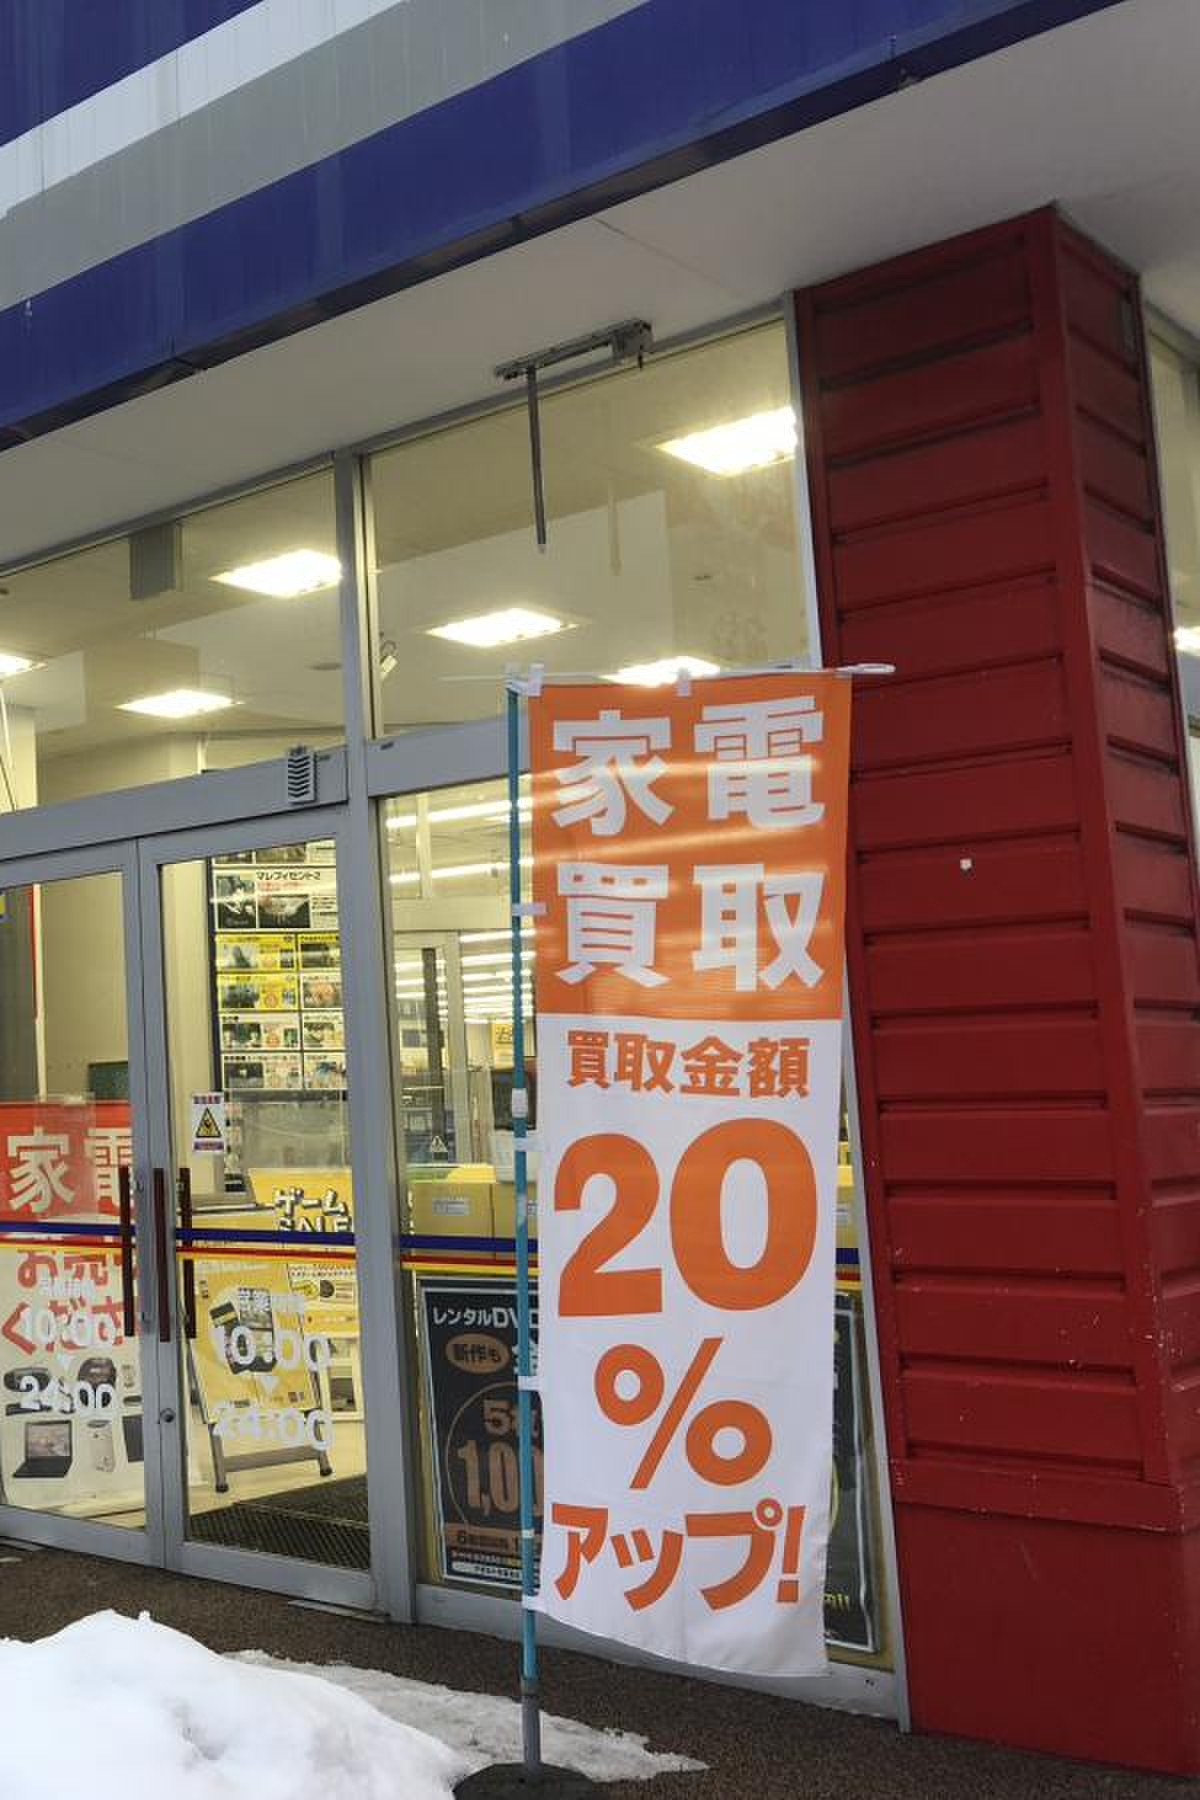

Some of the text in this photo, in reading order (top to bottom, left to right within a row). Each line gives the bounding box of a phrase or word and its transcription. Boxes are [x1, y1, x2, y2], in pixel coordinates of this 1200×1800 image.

[552, 696, 825, 836] 家電
[554, 863, 826, 992] 買取
[566, 1029, 812, 1098] 買取金額
[553, 1116, 818, 1317] 20
[594, 1336, 773, 1490] %
[551, 1497, 806, 1612] アップ!
